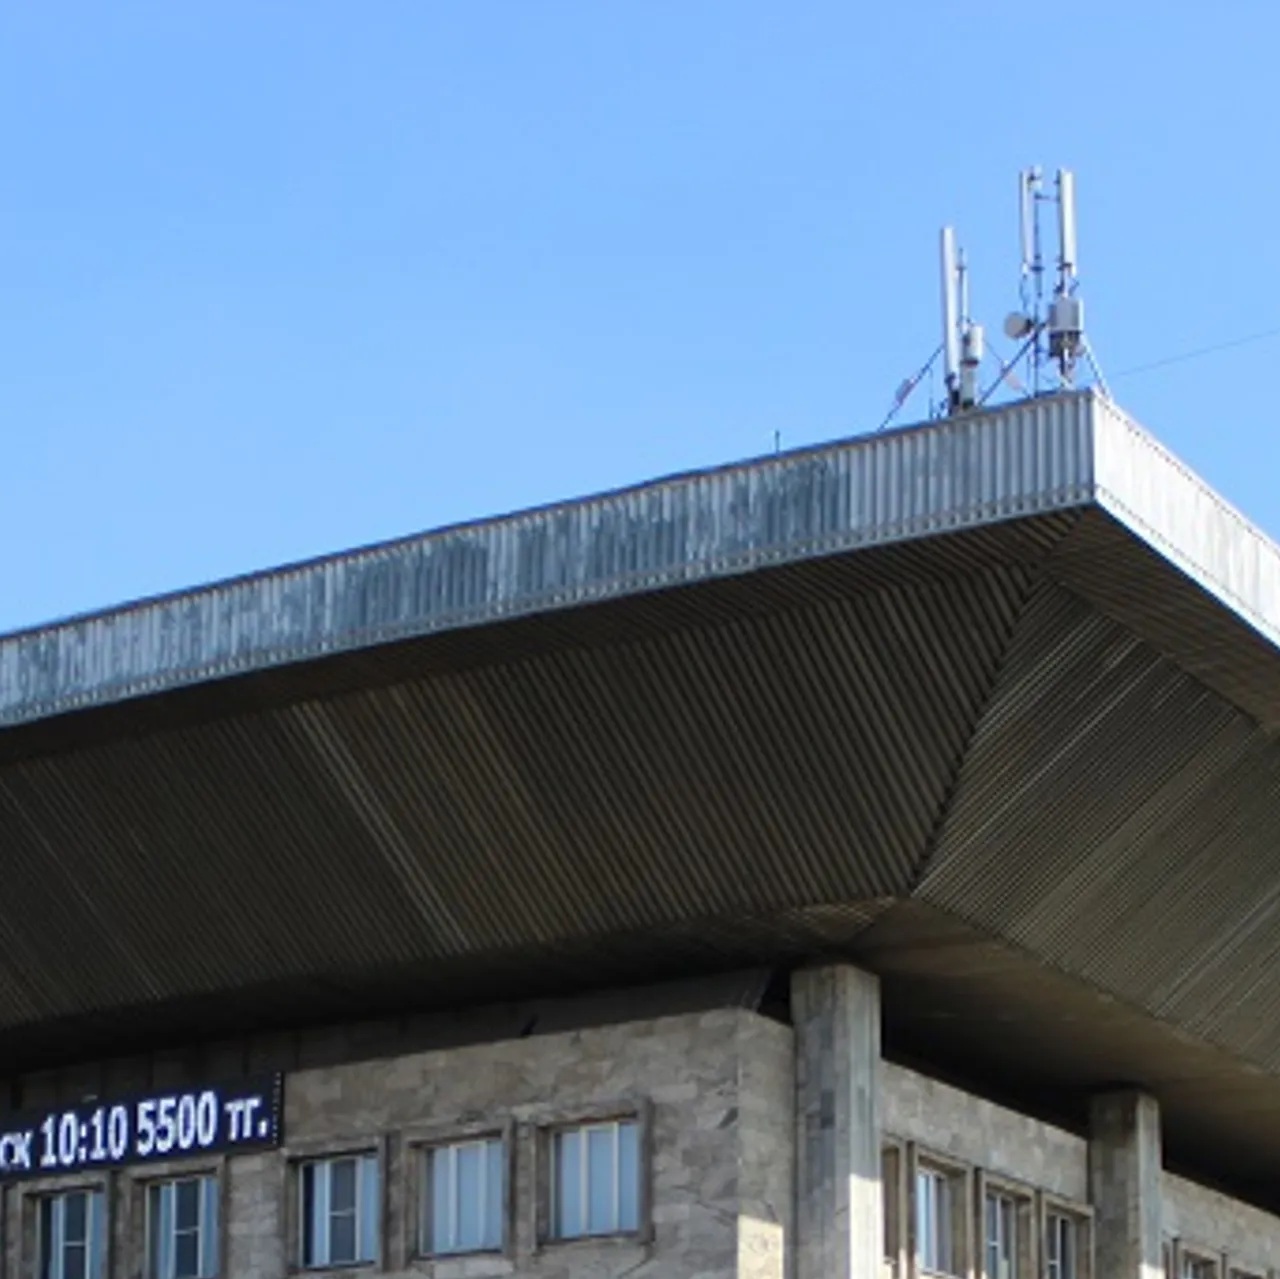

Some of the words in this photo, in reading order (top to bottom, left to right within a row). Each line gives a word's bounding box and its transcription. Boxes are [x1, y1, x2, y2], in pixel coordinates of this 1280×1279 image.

[40, 1109, 128, 1167] 10:10
[136, 1090, 218, 1156] 5500
[224, 1097, 267, 1141] тг.
